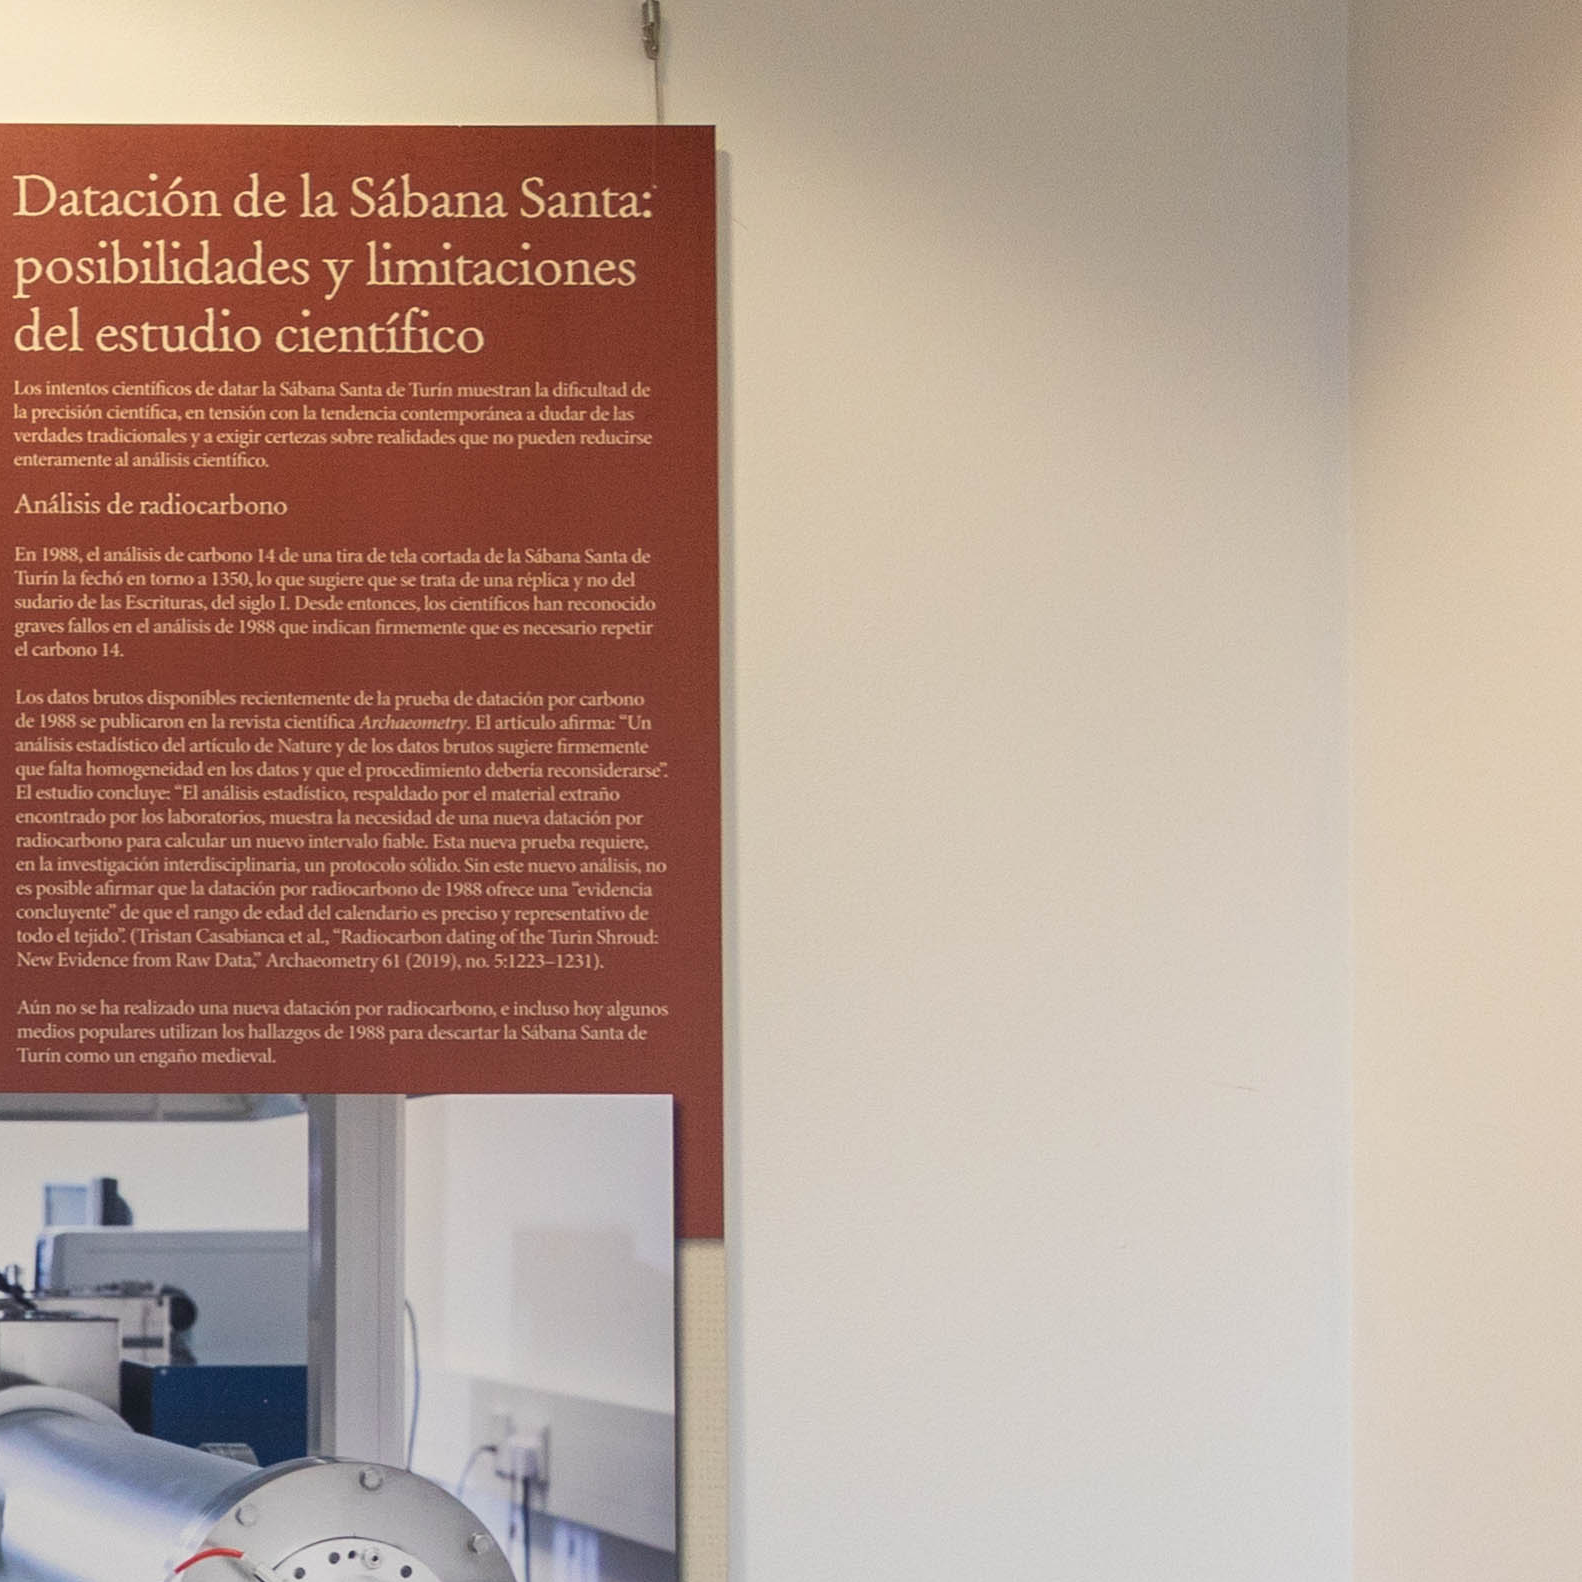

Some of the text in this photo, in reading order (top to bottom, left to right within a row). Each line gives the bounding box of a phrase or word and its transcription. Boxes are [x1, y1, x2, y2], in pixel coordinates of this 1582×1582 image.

[13, 173, 651, 218] Datación de la Sábana Santa:
[13, 239, 636, 300] posibilidades y limitaciones
[15, 307, 484, 353] del estudio científico
[14, 492, 287, 515] Análisis de radiocarbono
[15, 641, 124, 657] el carbono 14.
